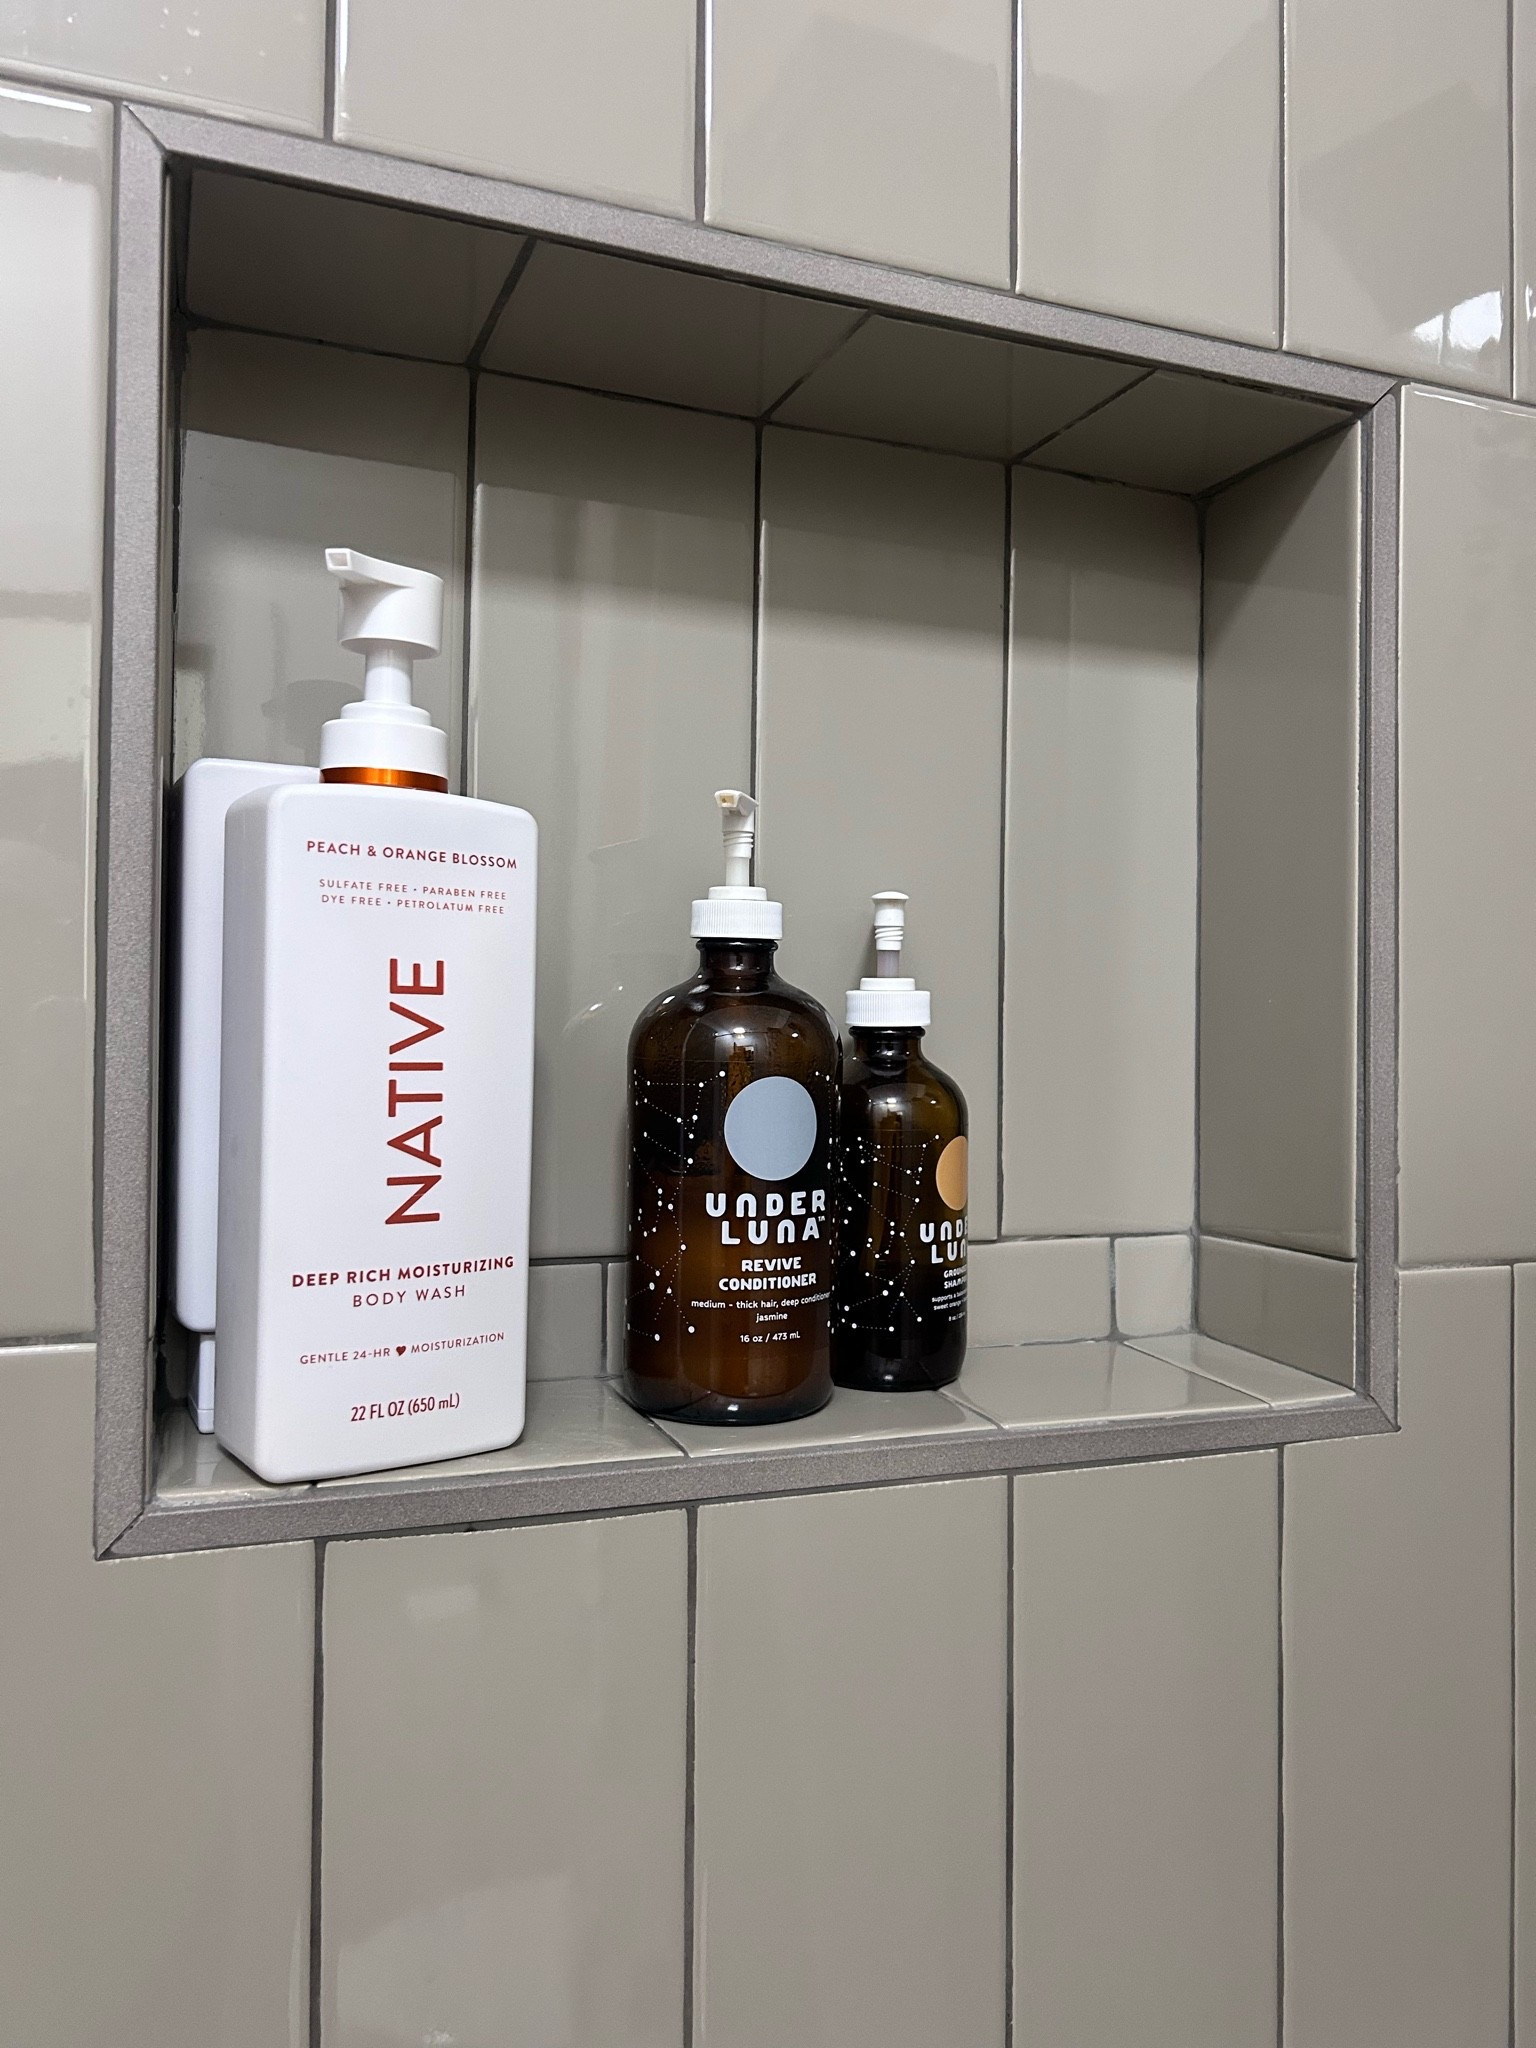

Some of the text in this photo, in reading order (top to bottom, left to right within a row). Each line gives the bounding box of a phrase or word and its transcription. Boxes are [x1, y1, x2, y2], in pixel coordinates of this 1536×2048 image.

[307, 840, 517, 869] PEACH & ORANGE BLOSSOM
[319, 879, 373, 891] SULFATE
[379, 883, 408, 893] FREE
[423, 886, 475, 898] PARABEN
[480, 891, 507, 900] FREE
[321, 894, 345, 904] DYE
[351, 896, 382, 906] FREE
[397, 899, 473, 912] PETROLATUM
[478, 905, 505, 915] FREE
[385, 958, 445, 1225] NATIVE
[705, 1189, 826, 1218] UNDER
[292, 1256, 515, 1287] DEEP RICH MOISTURIZING
[741, 1256, 802, 1273] REVIVE
[718, 1272, 817, 1291] CONDITIONER
[353, 1284, 466, 1308] BODY WASH
[691, 1299, 726, 1309] medium
[736, 1300, 759, 1309] thick
[761, 1300, 779, 1309] hair,
[781, 1299, 800, 1307] deep
[755, 1312, 788, 1323] jasmine
[740, 1334, 750, 1343] 16
[752, 1335, 763, 1343] oz
[772, 1332, 788, 1341] 473
[789, 1331, 801, 1339] mL
[299, 1332, 505, 1365] GENTLE 24-HR MOISTURIZATION
[350, 1392, 461, 1422] 22 FL OZ (650 mL)
